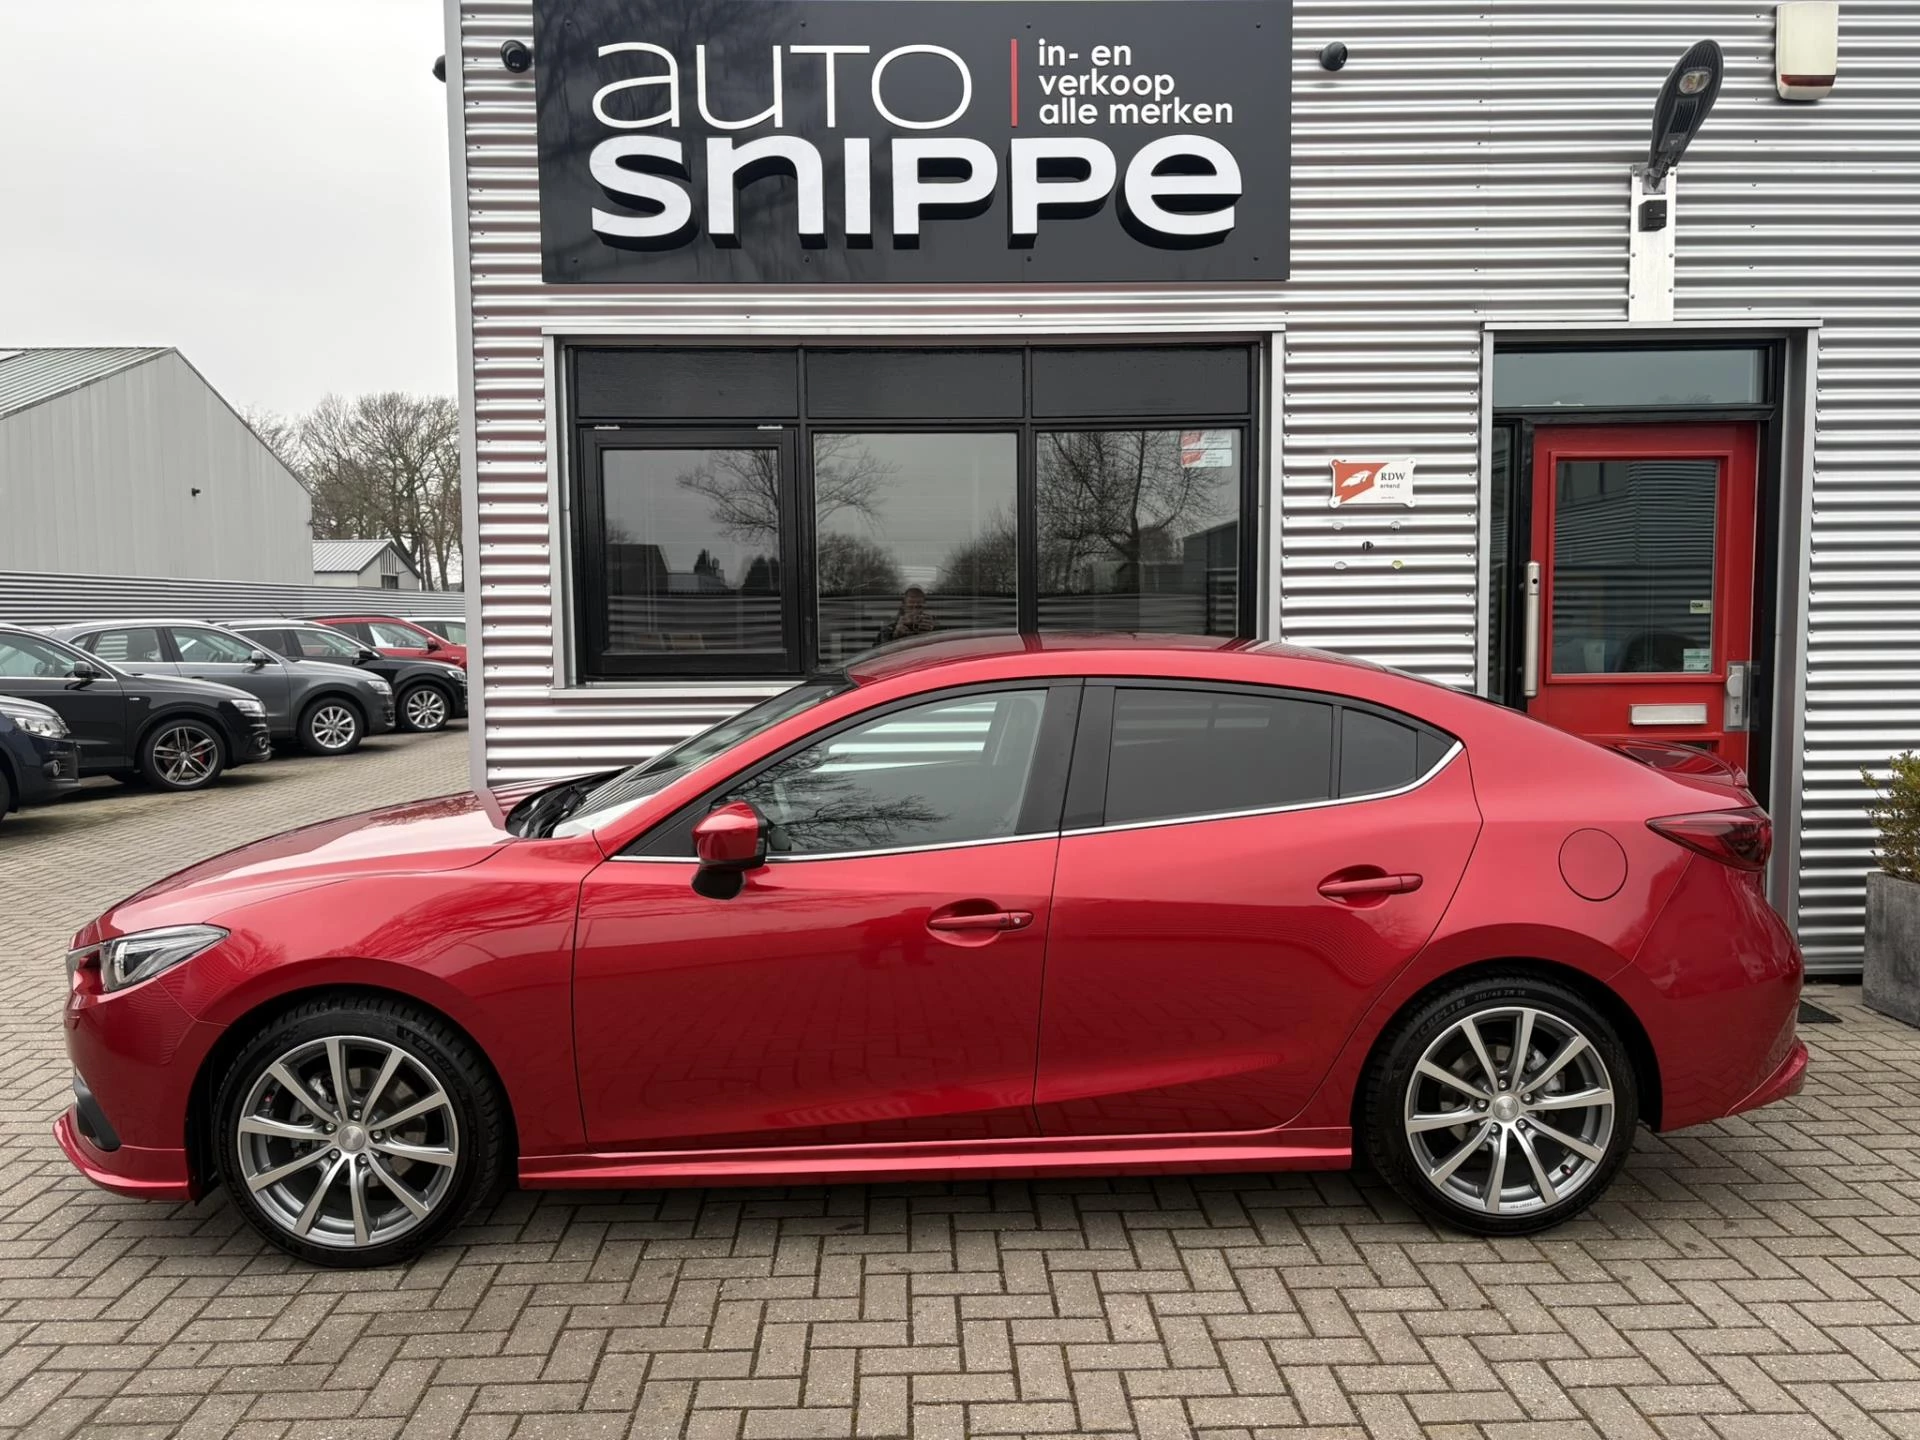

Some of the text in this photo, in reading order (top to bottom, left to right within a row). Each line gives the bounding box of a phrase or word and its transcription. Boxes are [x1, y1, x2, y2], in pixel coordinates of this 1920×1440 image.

[1038, 38, 1132, 66] in- en
[1038, 68, 1175, 102] verkoop
[1039, 97, 1233, 124] alle merken
[1380, 472, 1406, 481] RDW
